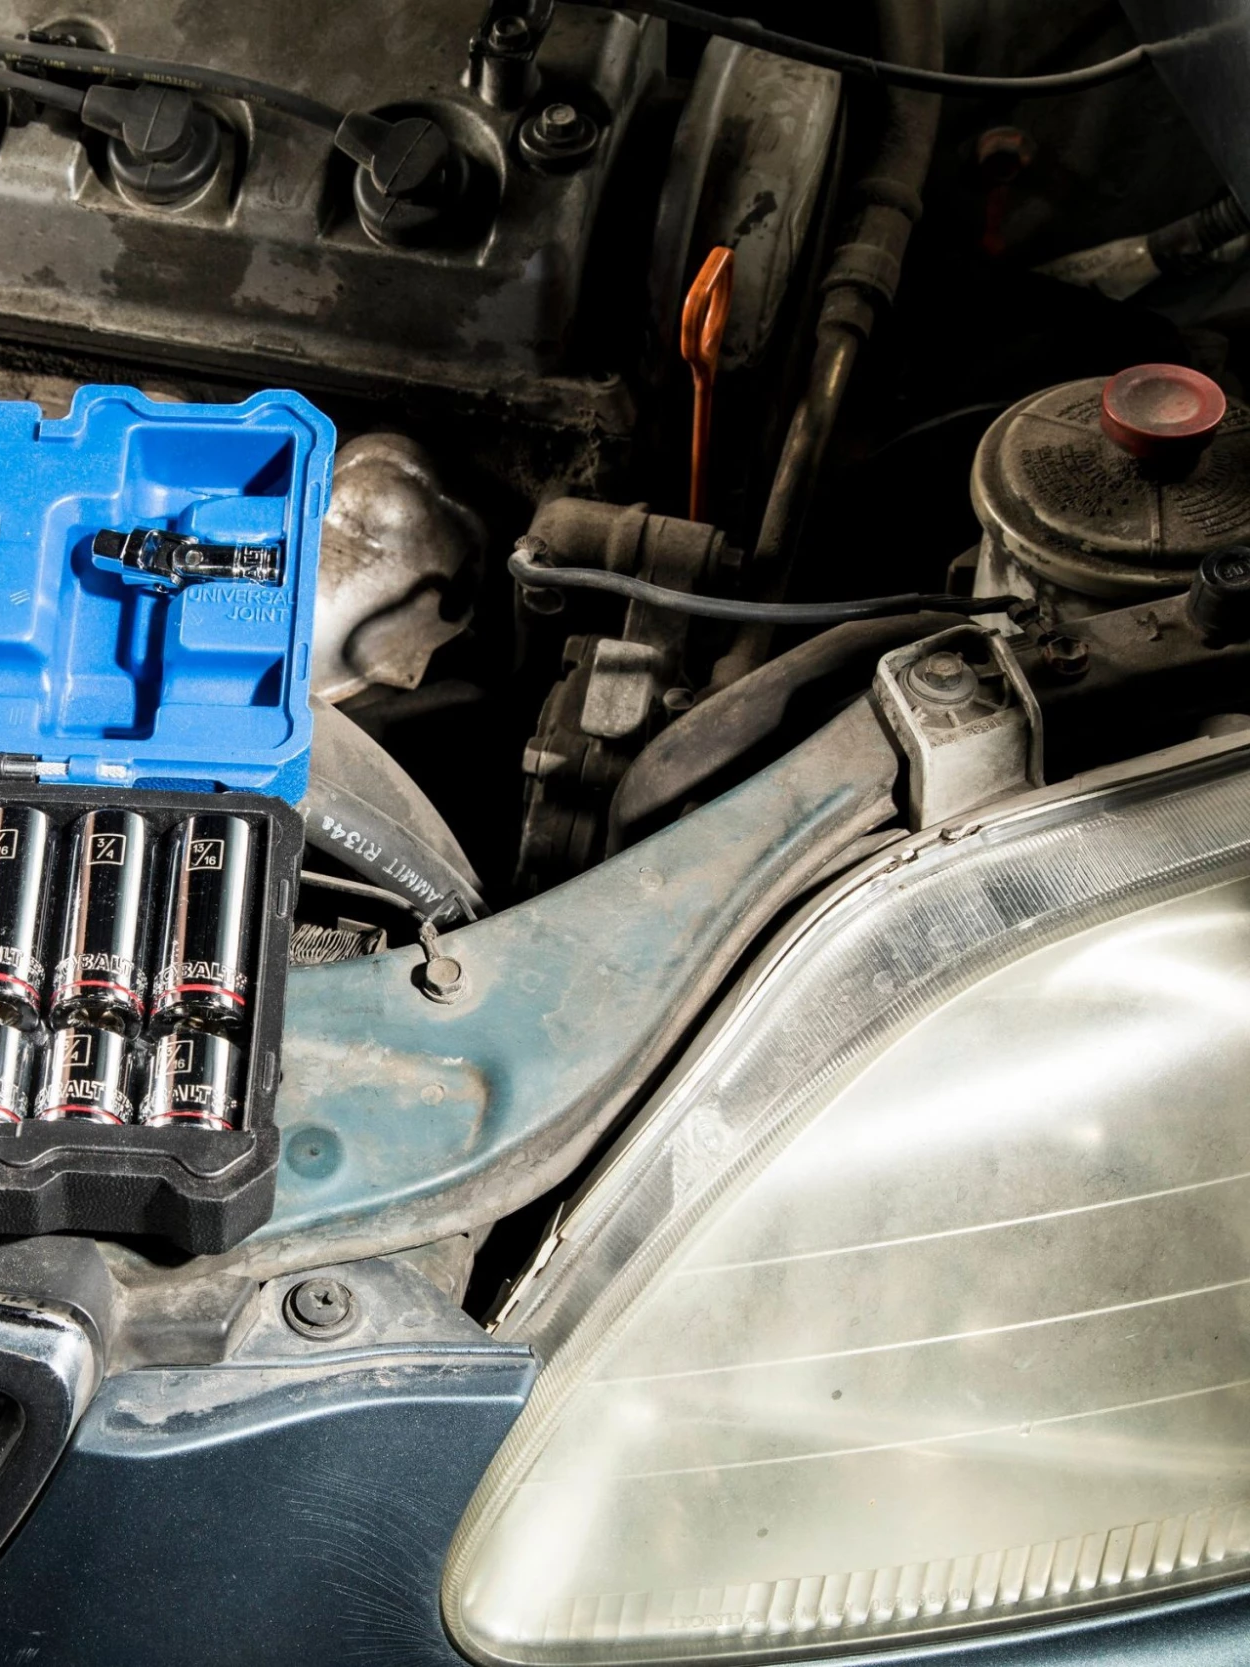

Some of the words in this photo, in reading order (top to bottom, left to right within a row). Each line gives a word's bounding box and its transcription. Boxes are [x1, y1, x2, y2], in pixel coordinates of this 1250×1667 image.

[188, 586, 295, 607] UNIVERSAL
[226, 606, 290, 623] JOINT
[96, 838, 116, 859] 3/4
[322, 815, 382, 862] R134a
[192, 842, 218, 867] 13/16
